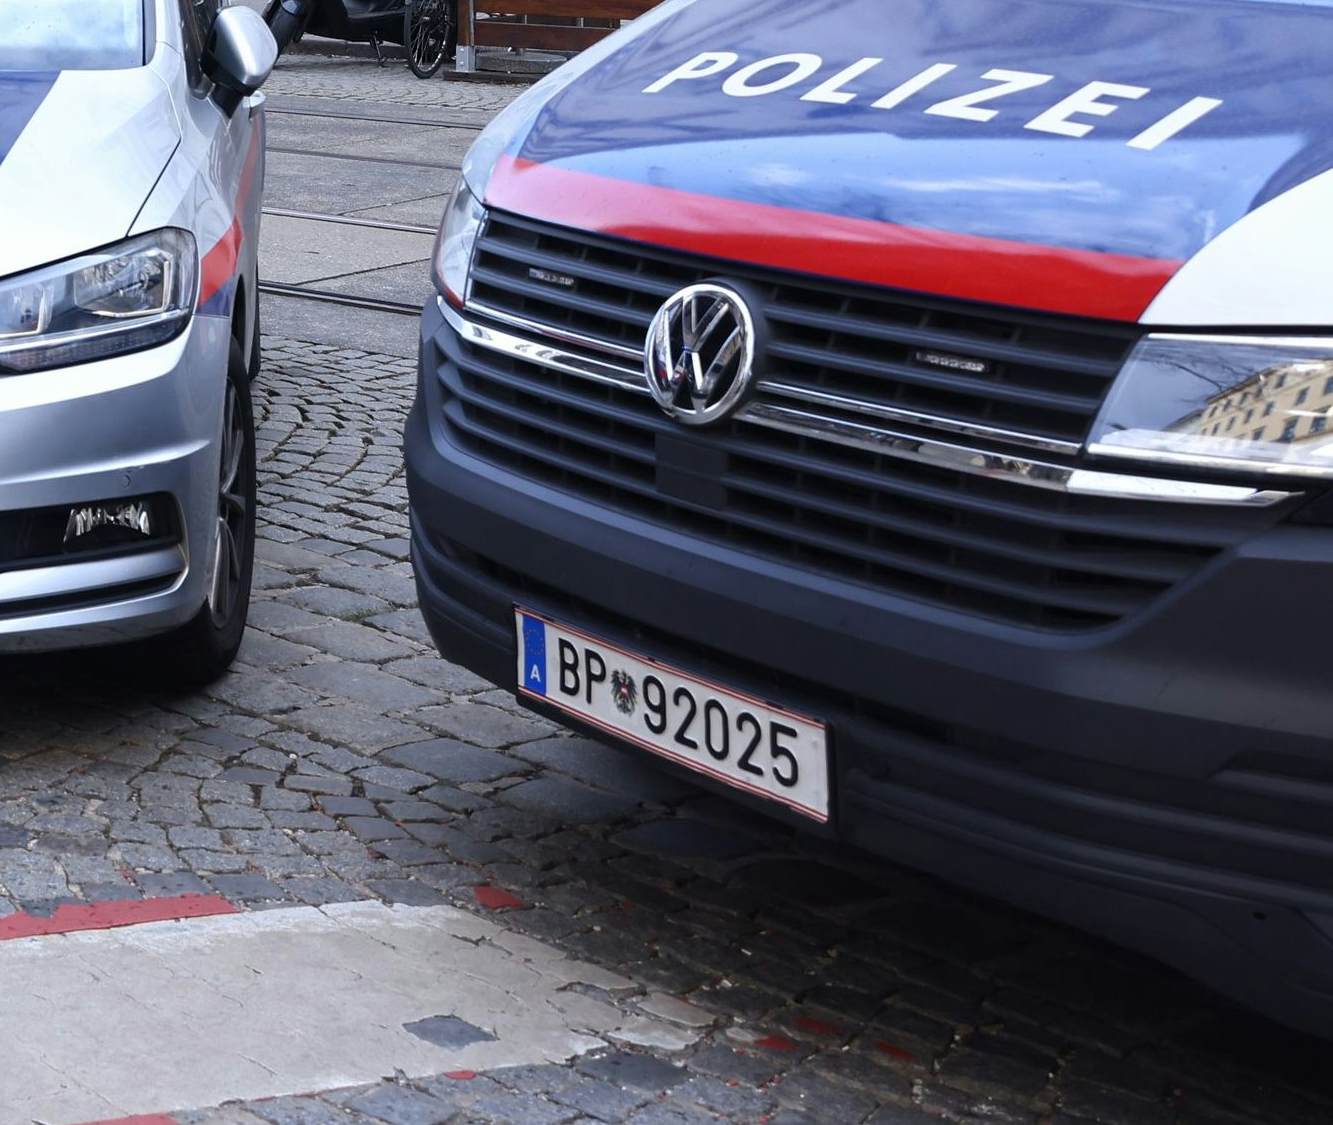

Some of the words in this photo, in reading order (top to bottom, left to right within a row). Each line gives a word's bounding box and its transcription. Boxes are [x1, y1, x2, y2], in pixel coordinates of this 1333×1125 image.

[641, 51, 1224, 151] POLIZEI
[558, 637, 607, 704] BP
[642, 675, 799, 787] 92025
